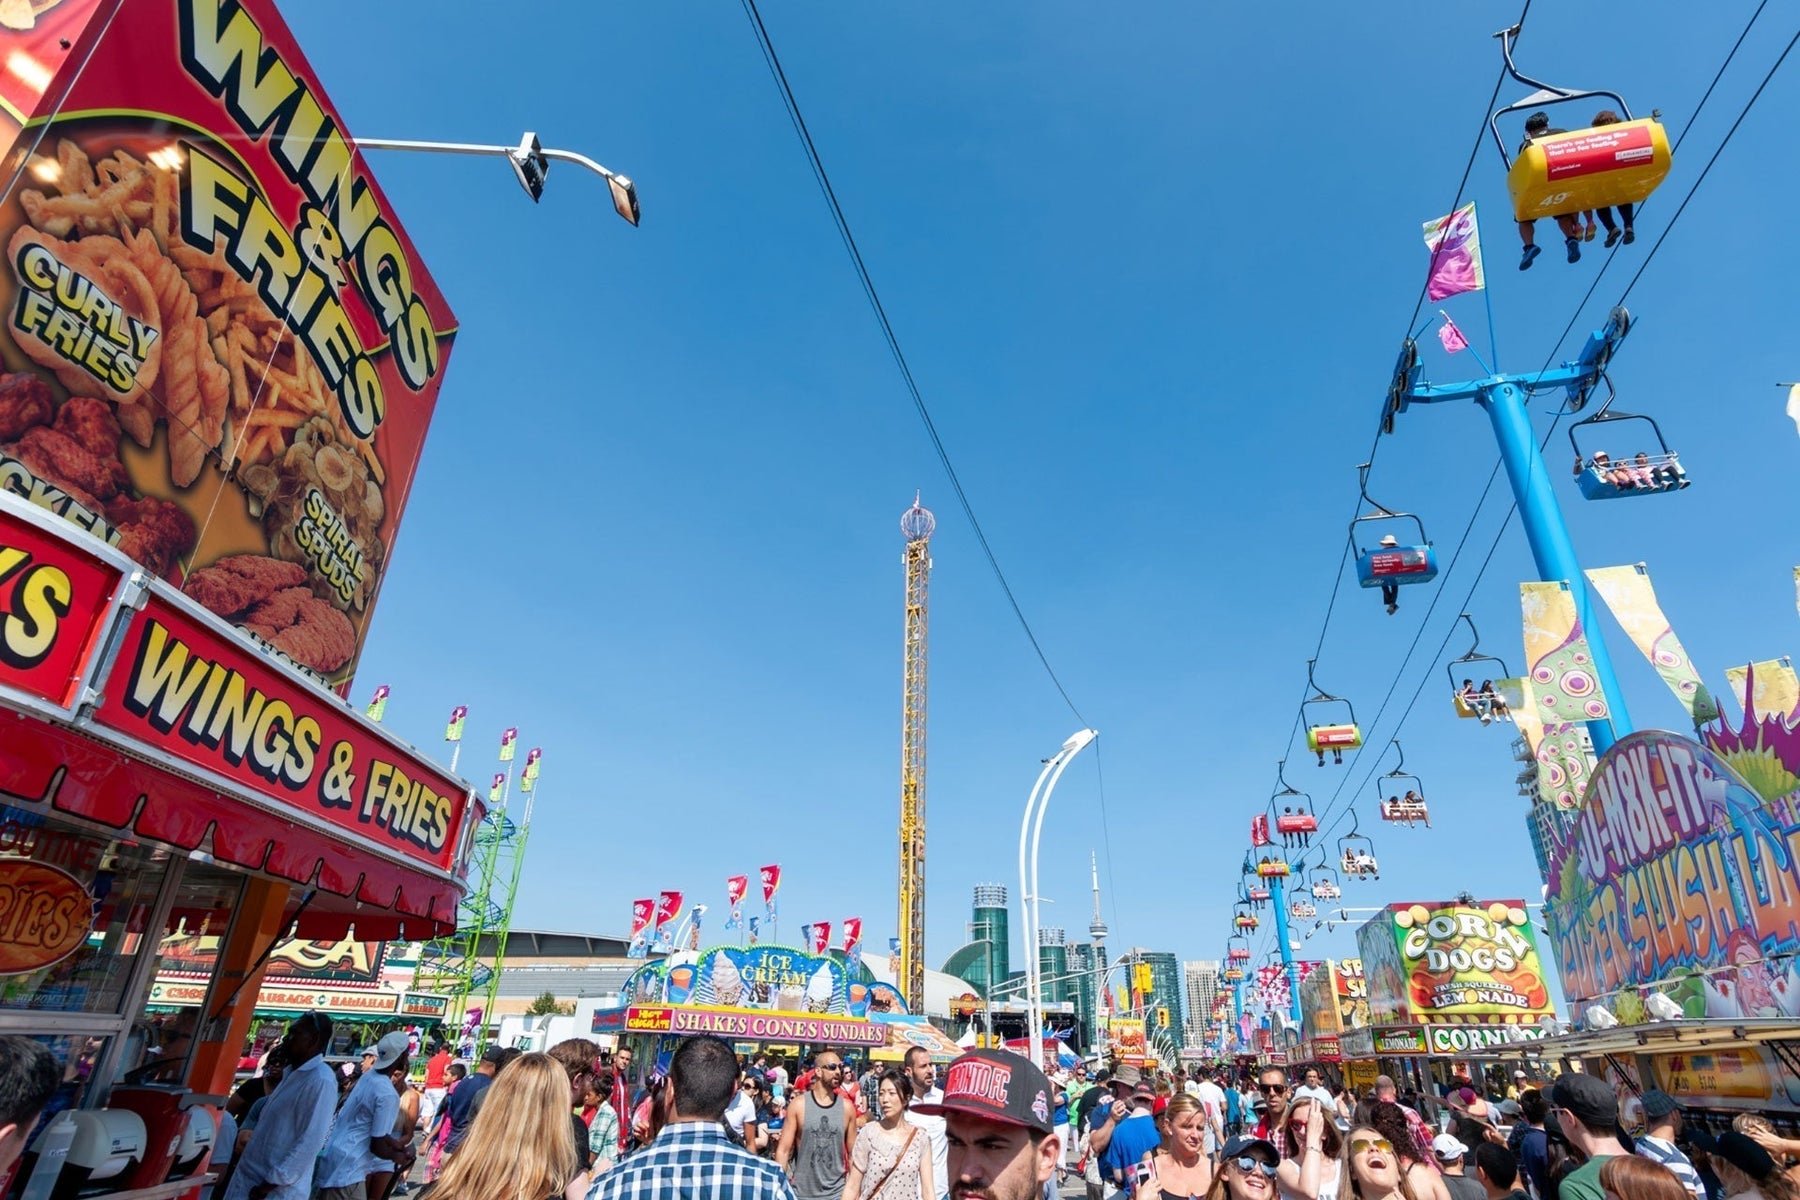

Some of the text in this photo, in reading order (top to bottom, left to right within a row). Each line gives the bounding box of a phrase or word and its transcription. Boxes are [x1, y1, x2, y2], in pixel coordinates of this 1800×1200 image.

[178, 0, 438, 391] WINGS
[299, 200, 348, 298] &
[17, 242, 159, 362] CURLY
[178, 140, 386, 439] FRIES
[14, 286, 141, 394] FRIES
[304, 488, 364, 582] SPIRAL
[295, 515, 355, 601] SPUDS
[123, 618, 322, 790] WINGS
[319, 740, 356, 809] &
[358, 759, 453, 854] FRIES
[1624, 834, 1744, 978] SLUSH
[1404, 912, 1533, 960] CORN
[761, 953, 792, 971] ICE
[1425, 947, 1517, 973] DOGS
[741, 966, 807, 986] CREAM
[1434, 981, 1514, 992] FRESH SQUEEZED
[405, 996, 444, 1007] ICE COLD
[407, 1004, 439, 1013] DRINKS
[1431, 989, 1529, 1009] LEMONADE
[628, 1018, 670, 1029] CHOCOLATE
[638, 1009, 663, 1018] HOT
[676, 1012, 748, 1036] SHAKES
[752, 1018, 818, 1039] CONES
[821, 1022, 884, 1045] SUNDAES
[1315, 1041, 1338, 1049] SPIRAL
[1316, 1048, 1338, 1056] SPUDS
[1381, 1037, 1419, 1050] LEMONADE
